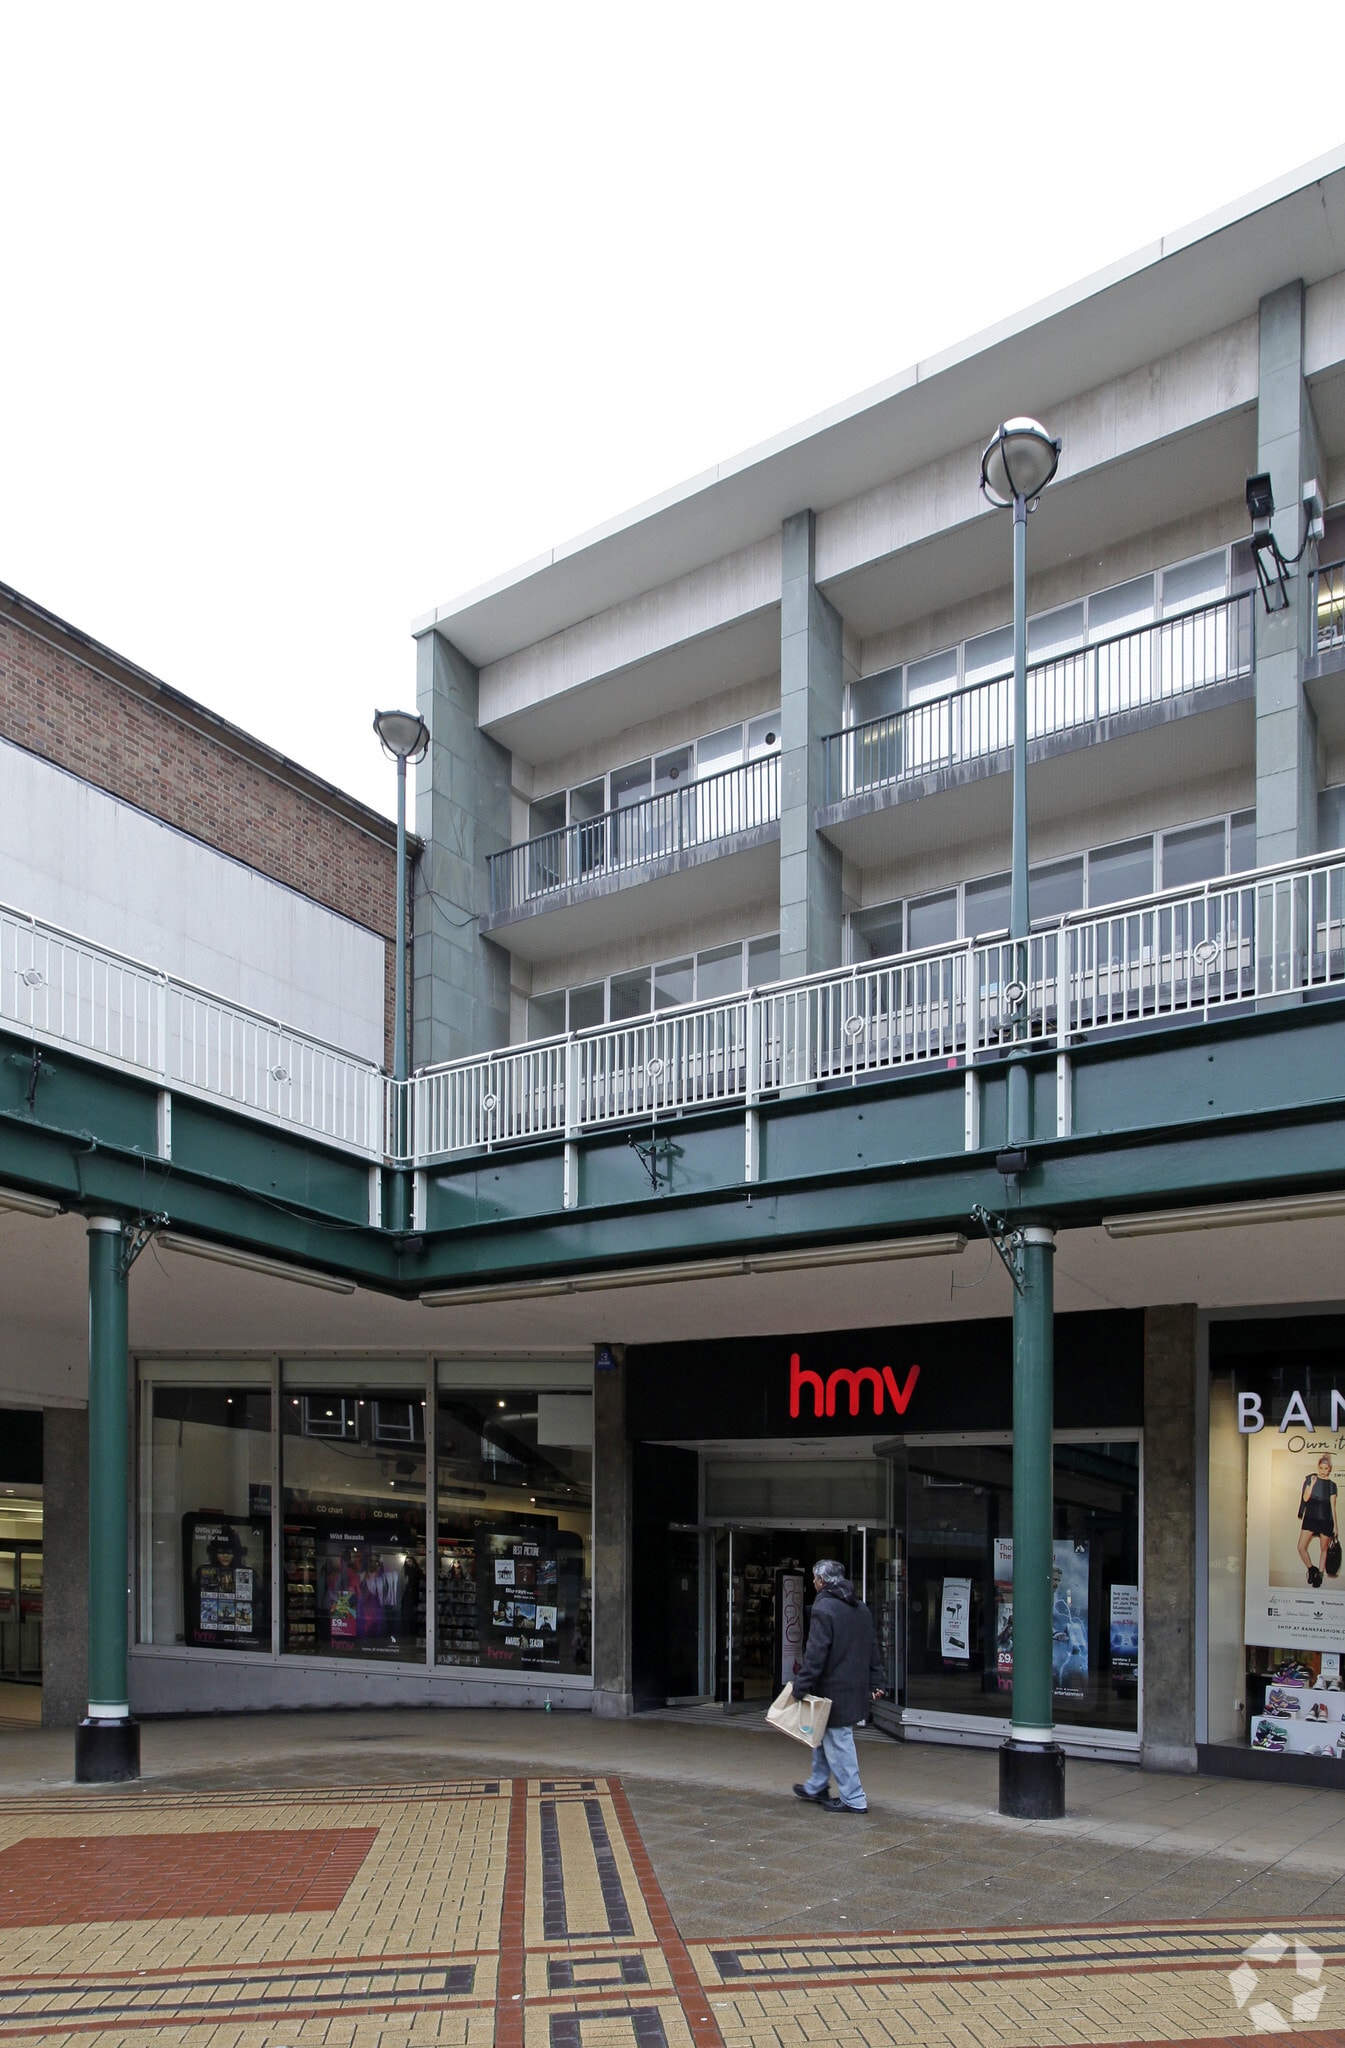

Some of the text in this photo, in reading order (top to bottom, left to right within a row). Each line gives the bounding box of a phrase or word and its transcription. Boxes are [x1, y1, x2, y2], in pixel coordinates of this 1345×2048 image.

[790, 1352, 920, 1418] hmv
[1288, 1435, 1330, 1453] Own
[316, 1504, 344, 1514] CD chart
[384, 1511, 398, 1519] chart
[211, 1528, 222, 1536] you
[512, 1546, 540, 1557] BEST PICTURE
[192, 1628, 217, 1642] hmv
[330, 1639, 354, 1651] hmv
[529, 1638, 544, 1648] SEASON
[486, 1646, 513, 1660] hmv
